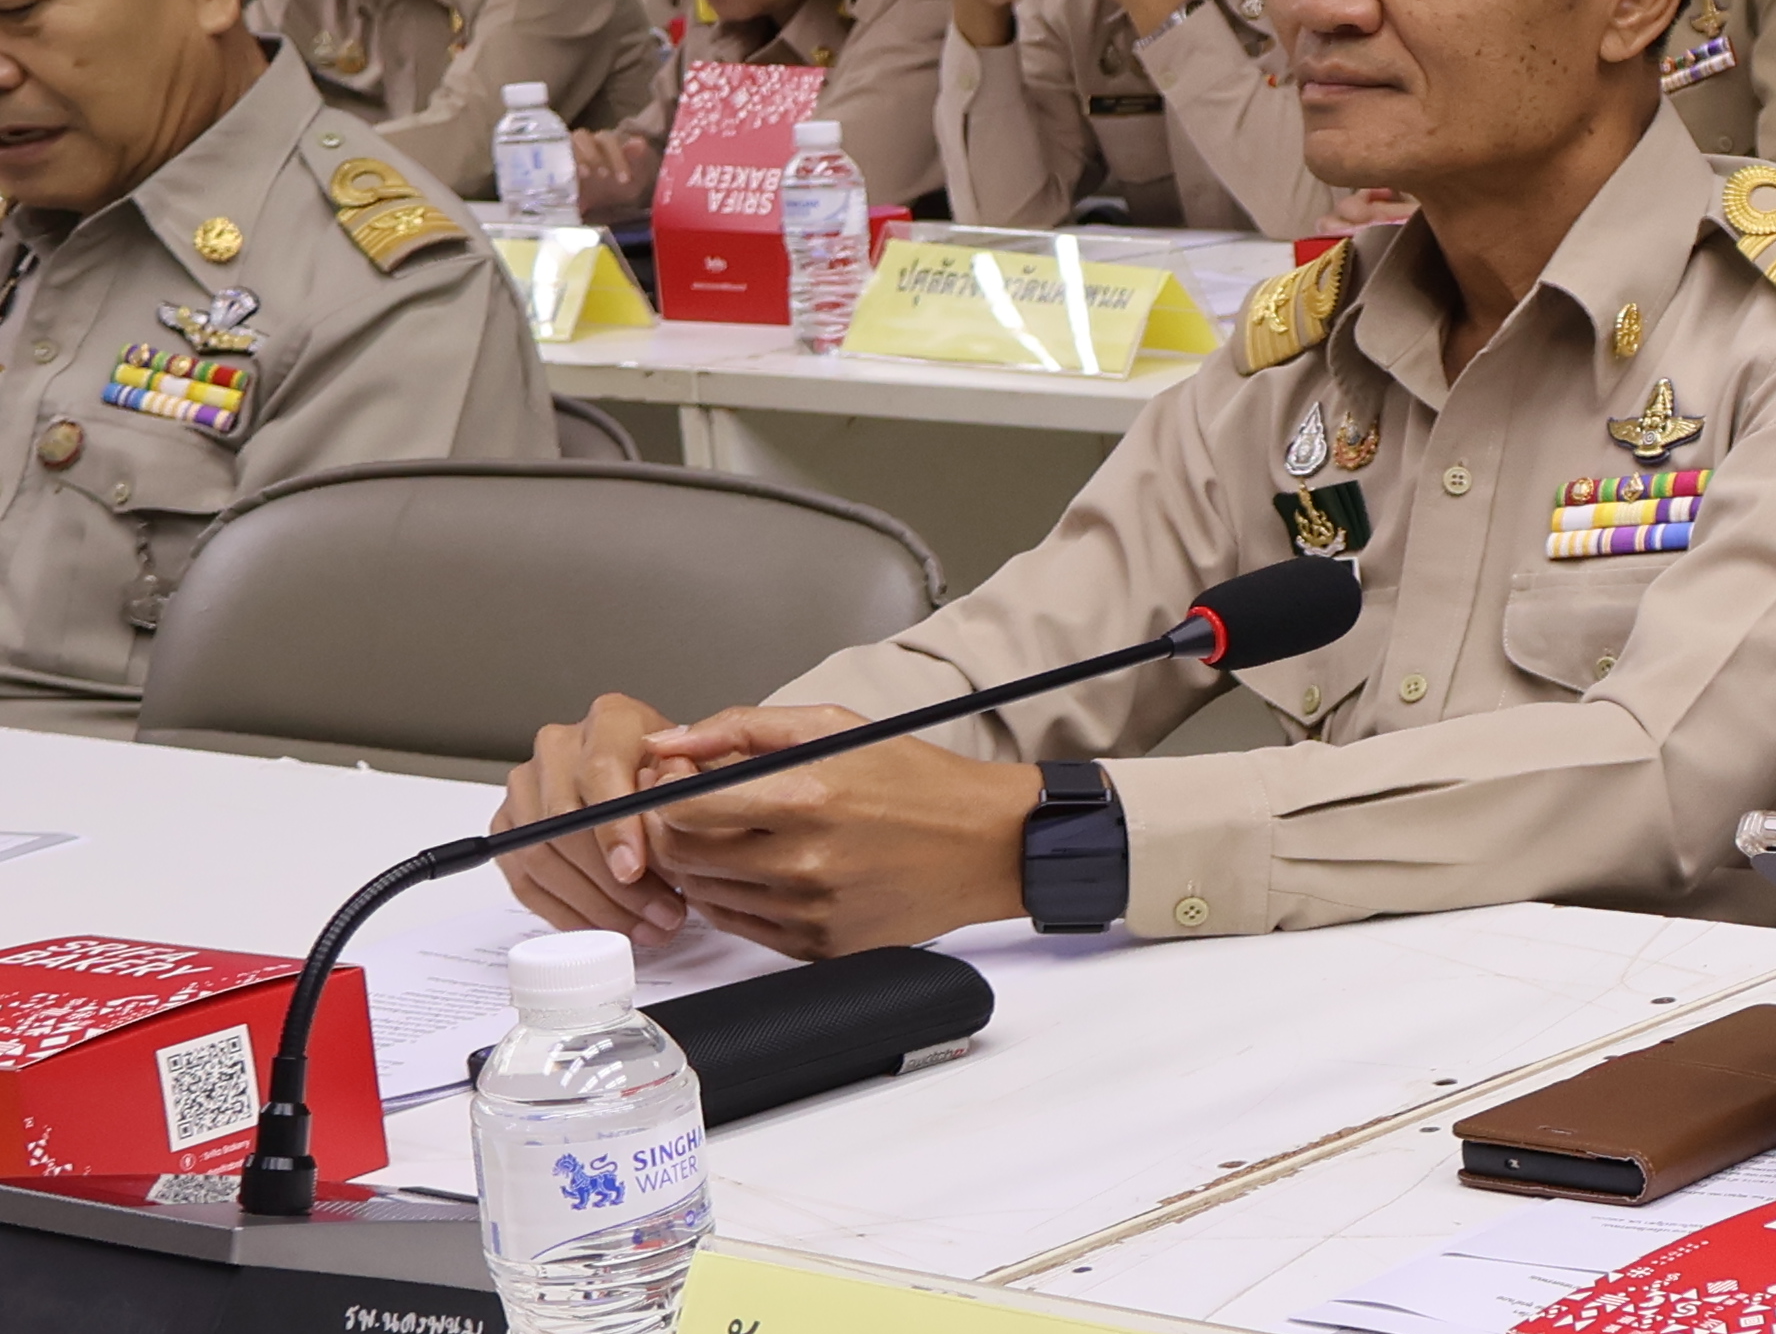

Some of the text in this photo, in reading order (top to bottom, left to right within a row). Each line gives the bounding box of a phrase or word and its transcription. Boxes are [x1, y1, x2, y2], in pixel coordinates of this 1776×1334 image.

[686, 164, 781, 191] BAKERY
[708, 189, 775, 215] SRIFA
[0, 950, 214, 979] BAKERY
[48, 940, 200, 963] SRIFA
[634, 1154, 699, 1195] WATER
